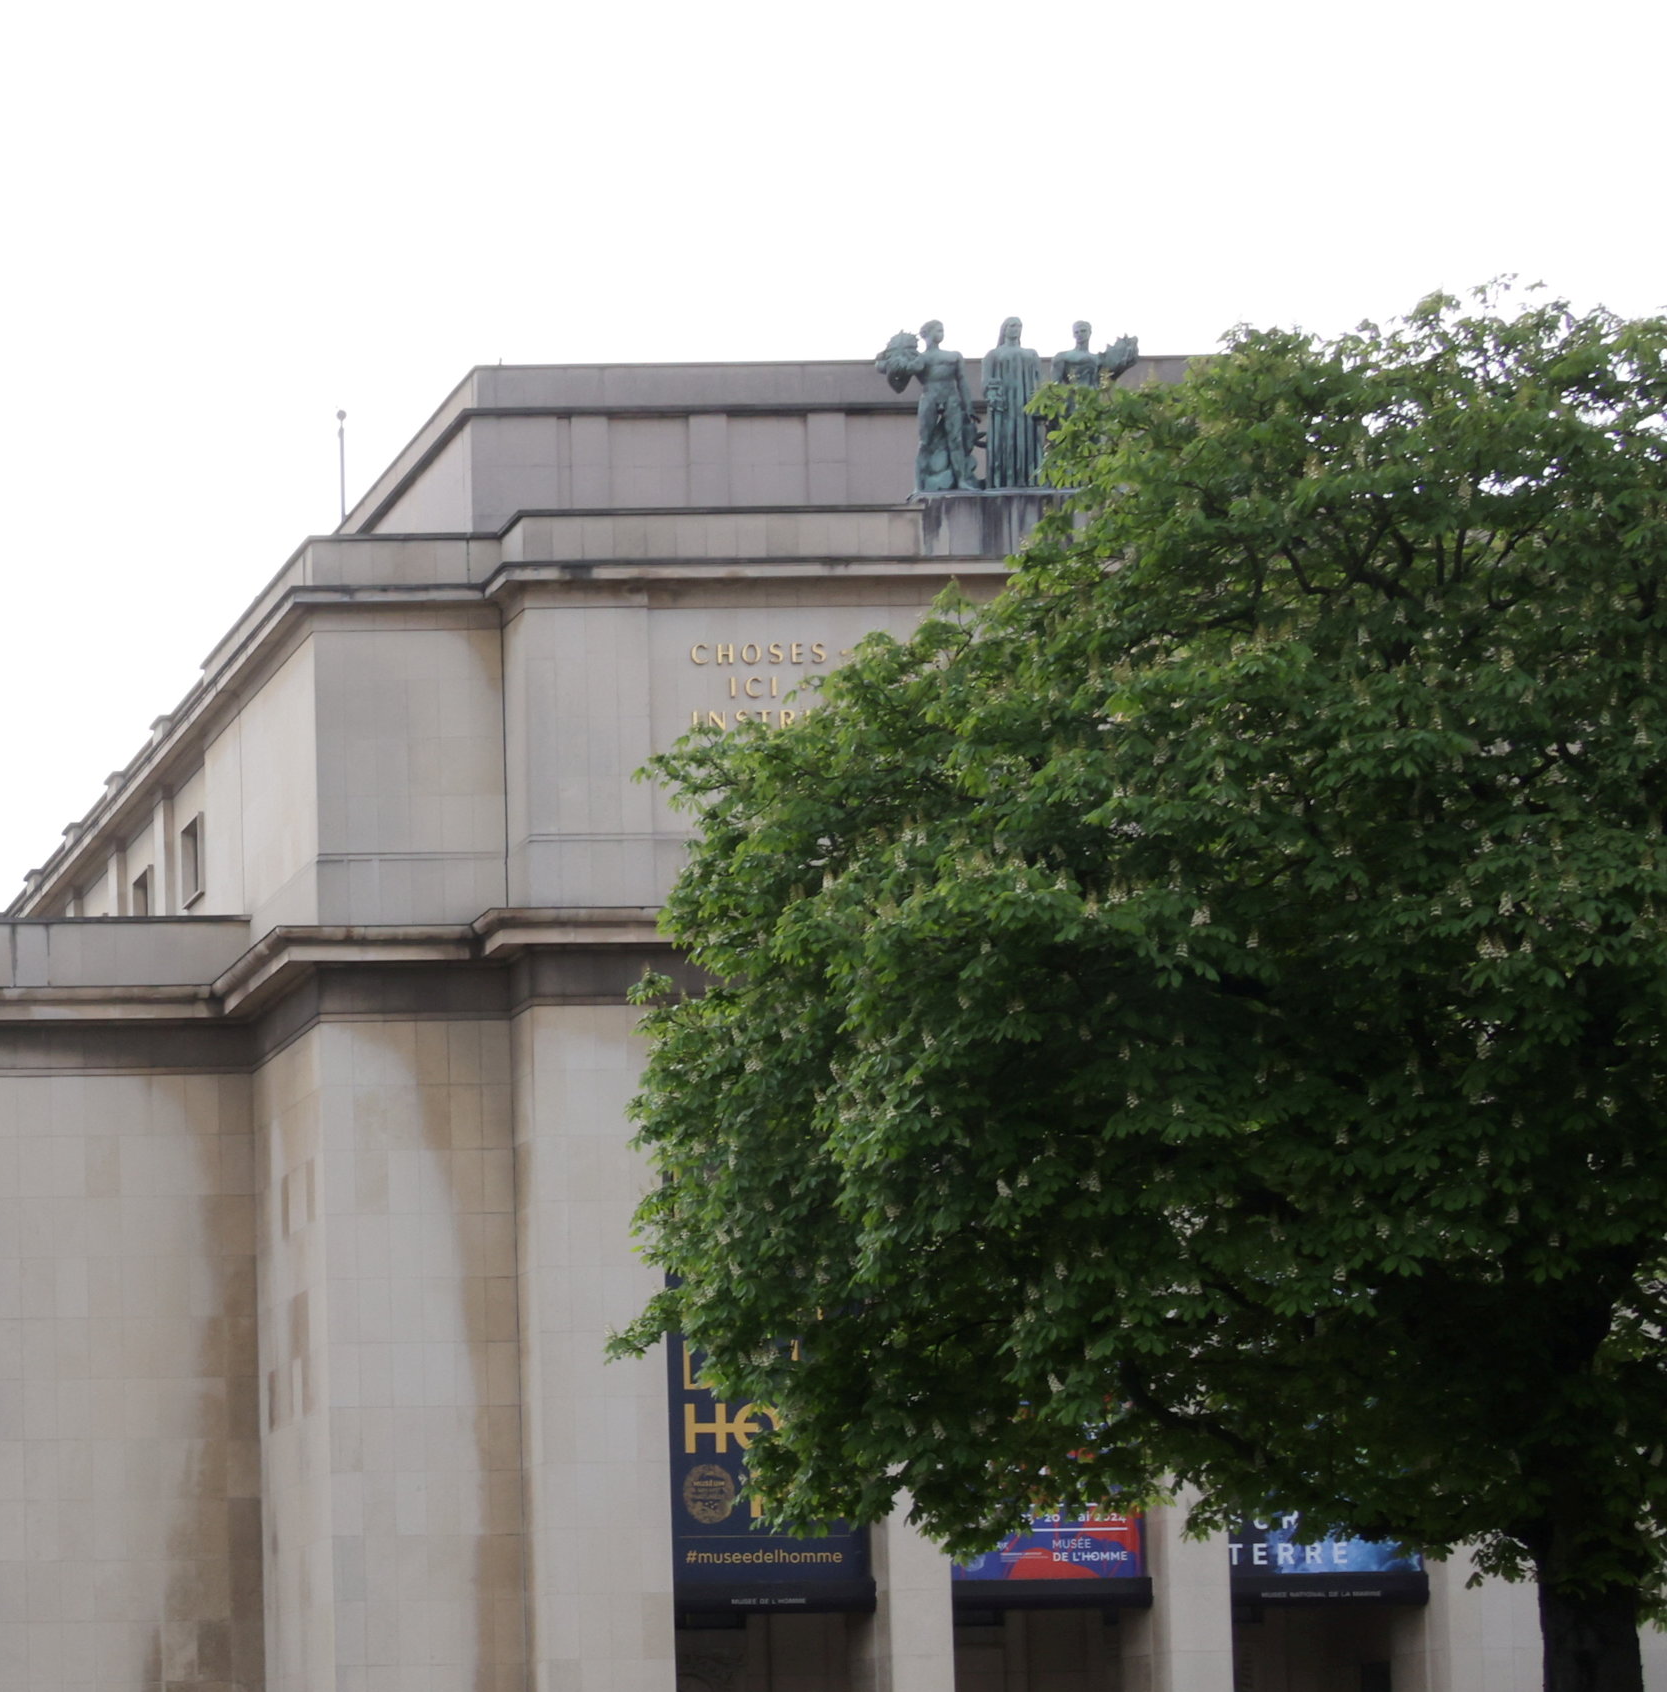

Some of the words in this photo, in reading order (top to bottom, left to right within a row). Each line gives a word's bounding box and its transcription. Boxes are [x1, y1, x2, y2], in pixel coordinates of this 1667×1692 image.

[690, 642, 828, 666] CHOSES
[729, 675, 780, 699] ICI
[1052, 1538, 1092, 1549] MUSÉE
[685, 1549, 844, 1564] #museedelhomme
[1052, 1552, 1069, 1562] DE
[1072, 1551, 1128, 1562] L'HOMME
[1228, 1541, 1349, 1566] TERRE
